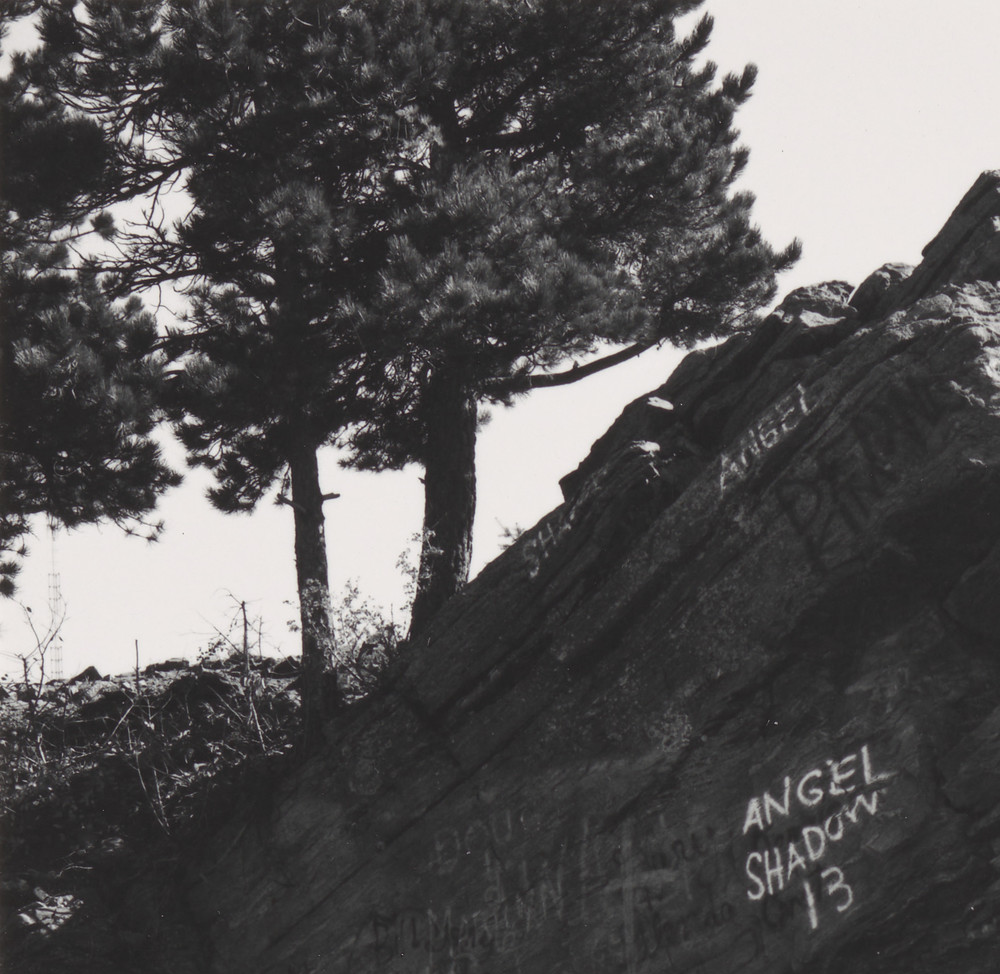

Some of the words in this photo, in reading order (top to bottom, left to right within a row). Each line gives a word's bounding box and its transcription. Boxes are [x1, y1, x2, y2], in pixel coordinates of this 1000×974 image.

[742, 744, 898, 834] ANGEL
[745, 790, 886, 900] SHADOW
[803, 865, 853, 929] 13
